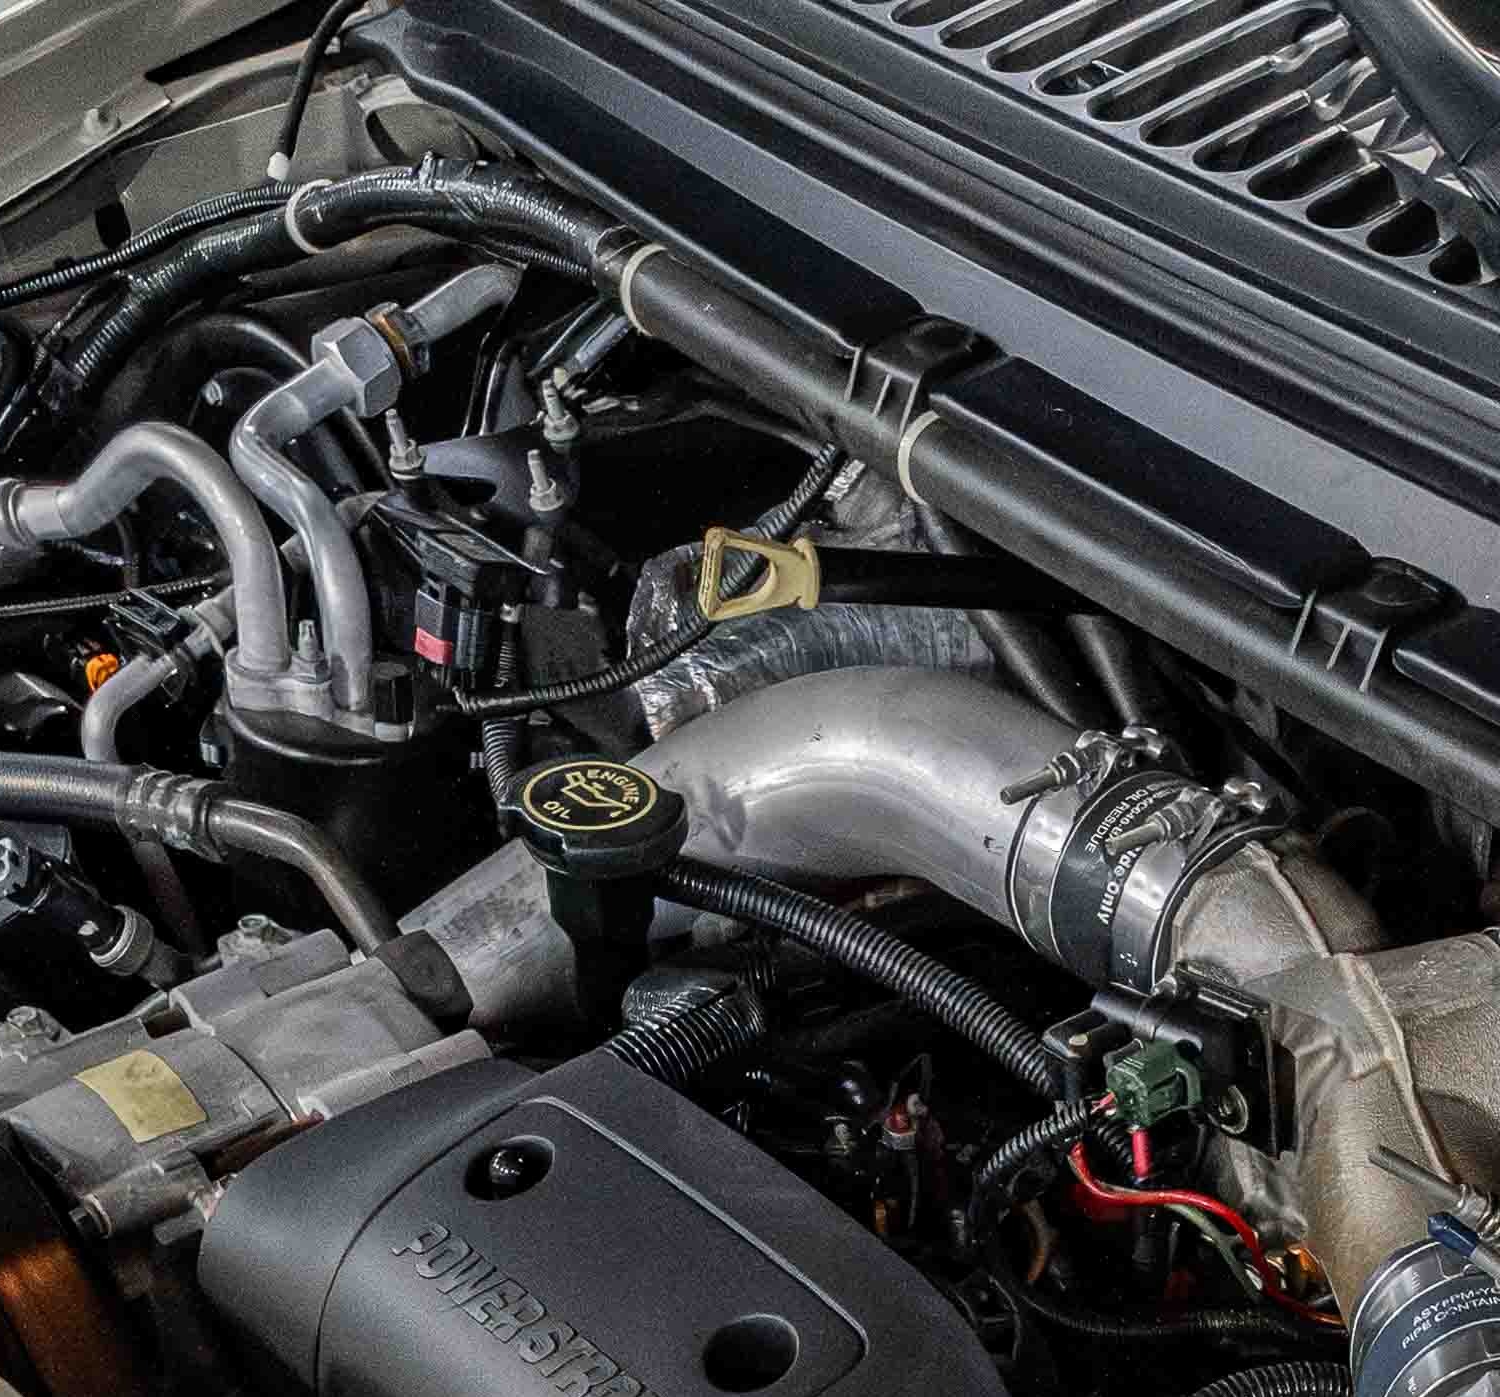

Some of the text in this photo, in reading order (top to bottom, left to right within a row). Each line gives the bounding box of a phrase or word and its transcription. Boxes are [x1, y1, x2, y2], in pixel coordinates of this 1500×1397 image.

[588, 769, 640, 804] ENGINE
[1124, 787, 1144, 802] OIL
[543, 800, 571, 819] OIL
[1083, 800, 1128, 854] RESIDUE
[1096, 879, 1120, 925] Only
[1401, 1317, 1432, 1349] PIPE
